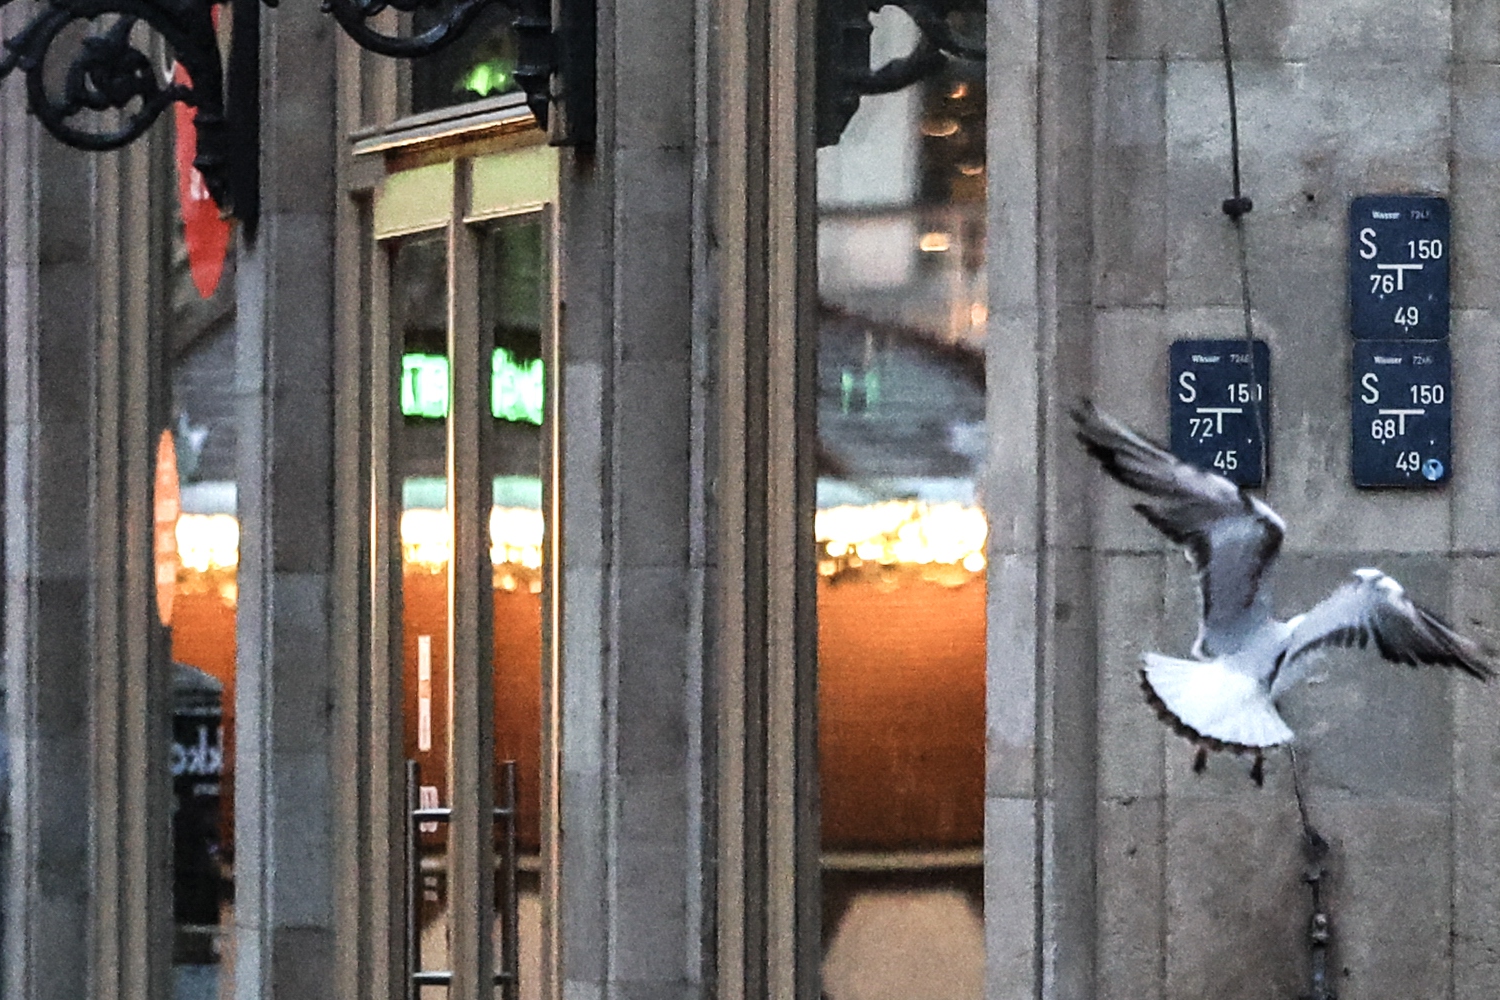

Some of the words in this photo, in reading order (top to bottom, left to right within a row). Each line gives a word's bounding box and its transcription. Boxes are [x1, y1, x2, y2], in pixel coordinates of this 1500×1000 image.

[1359, 227, 1378, 260] S
[1407, 239, 1443, 260] 150
[1369, 274, 1395, 294] 76
[1394, 306, 1419, 326] 49
[1178, 370, 1197, 403] S
[1361, 372, 1380, 404] S
[1410, 384, 1445, 404] 150
[1189, 417, 1214, 437] 72
[1371, 419, 1396, 439] 68
[1213, 450, 1238, 470] 45
[1395, 451, 1420, 471] 49
